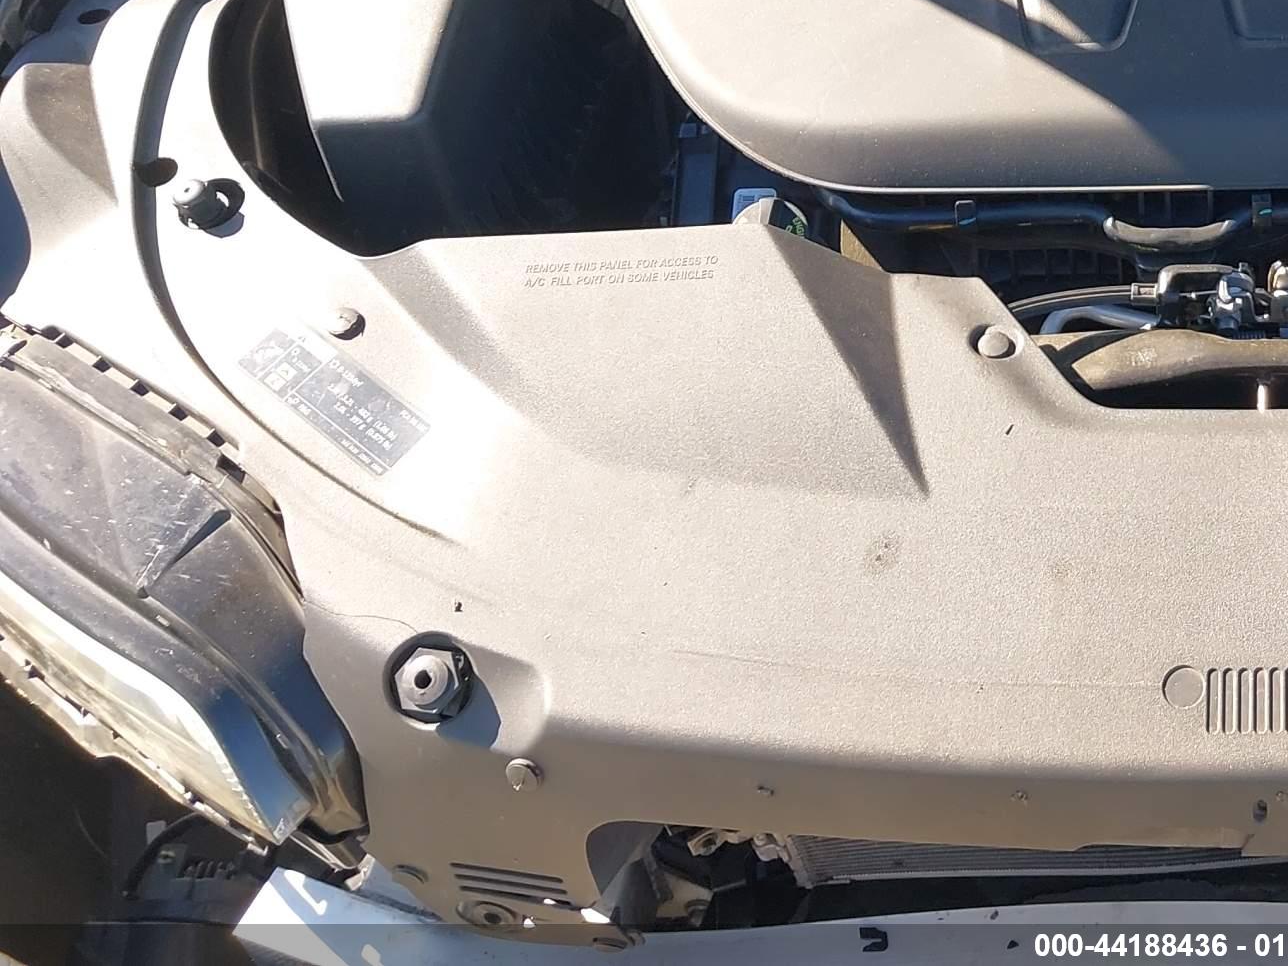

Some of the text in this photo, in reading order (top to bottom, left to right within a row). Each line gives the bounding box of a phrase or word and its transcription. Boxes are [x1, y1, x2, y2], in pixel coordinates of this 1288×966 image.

[526, 255, 719, 274] REMOVE THIS PANEL FOR ACCESS TO
[524, 269, 715, 288] A/C FILL PORT ON SOME VEHICLES
